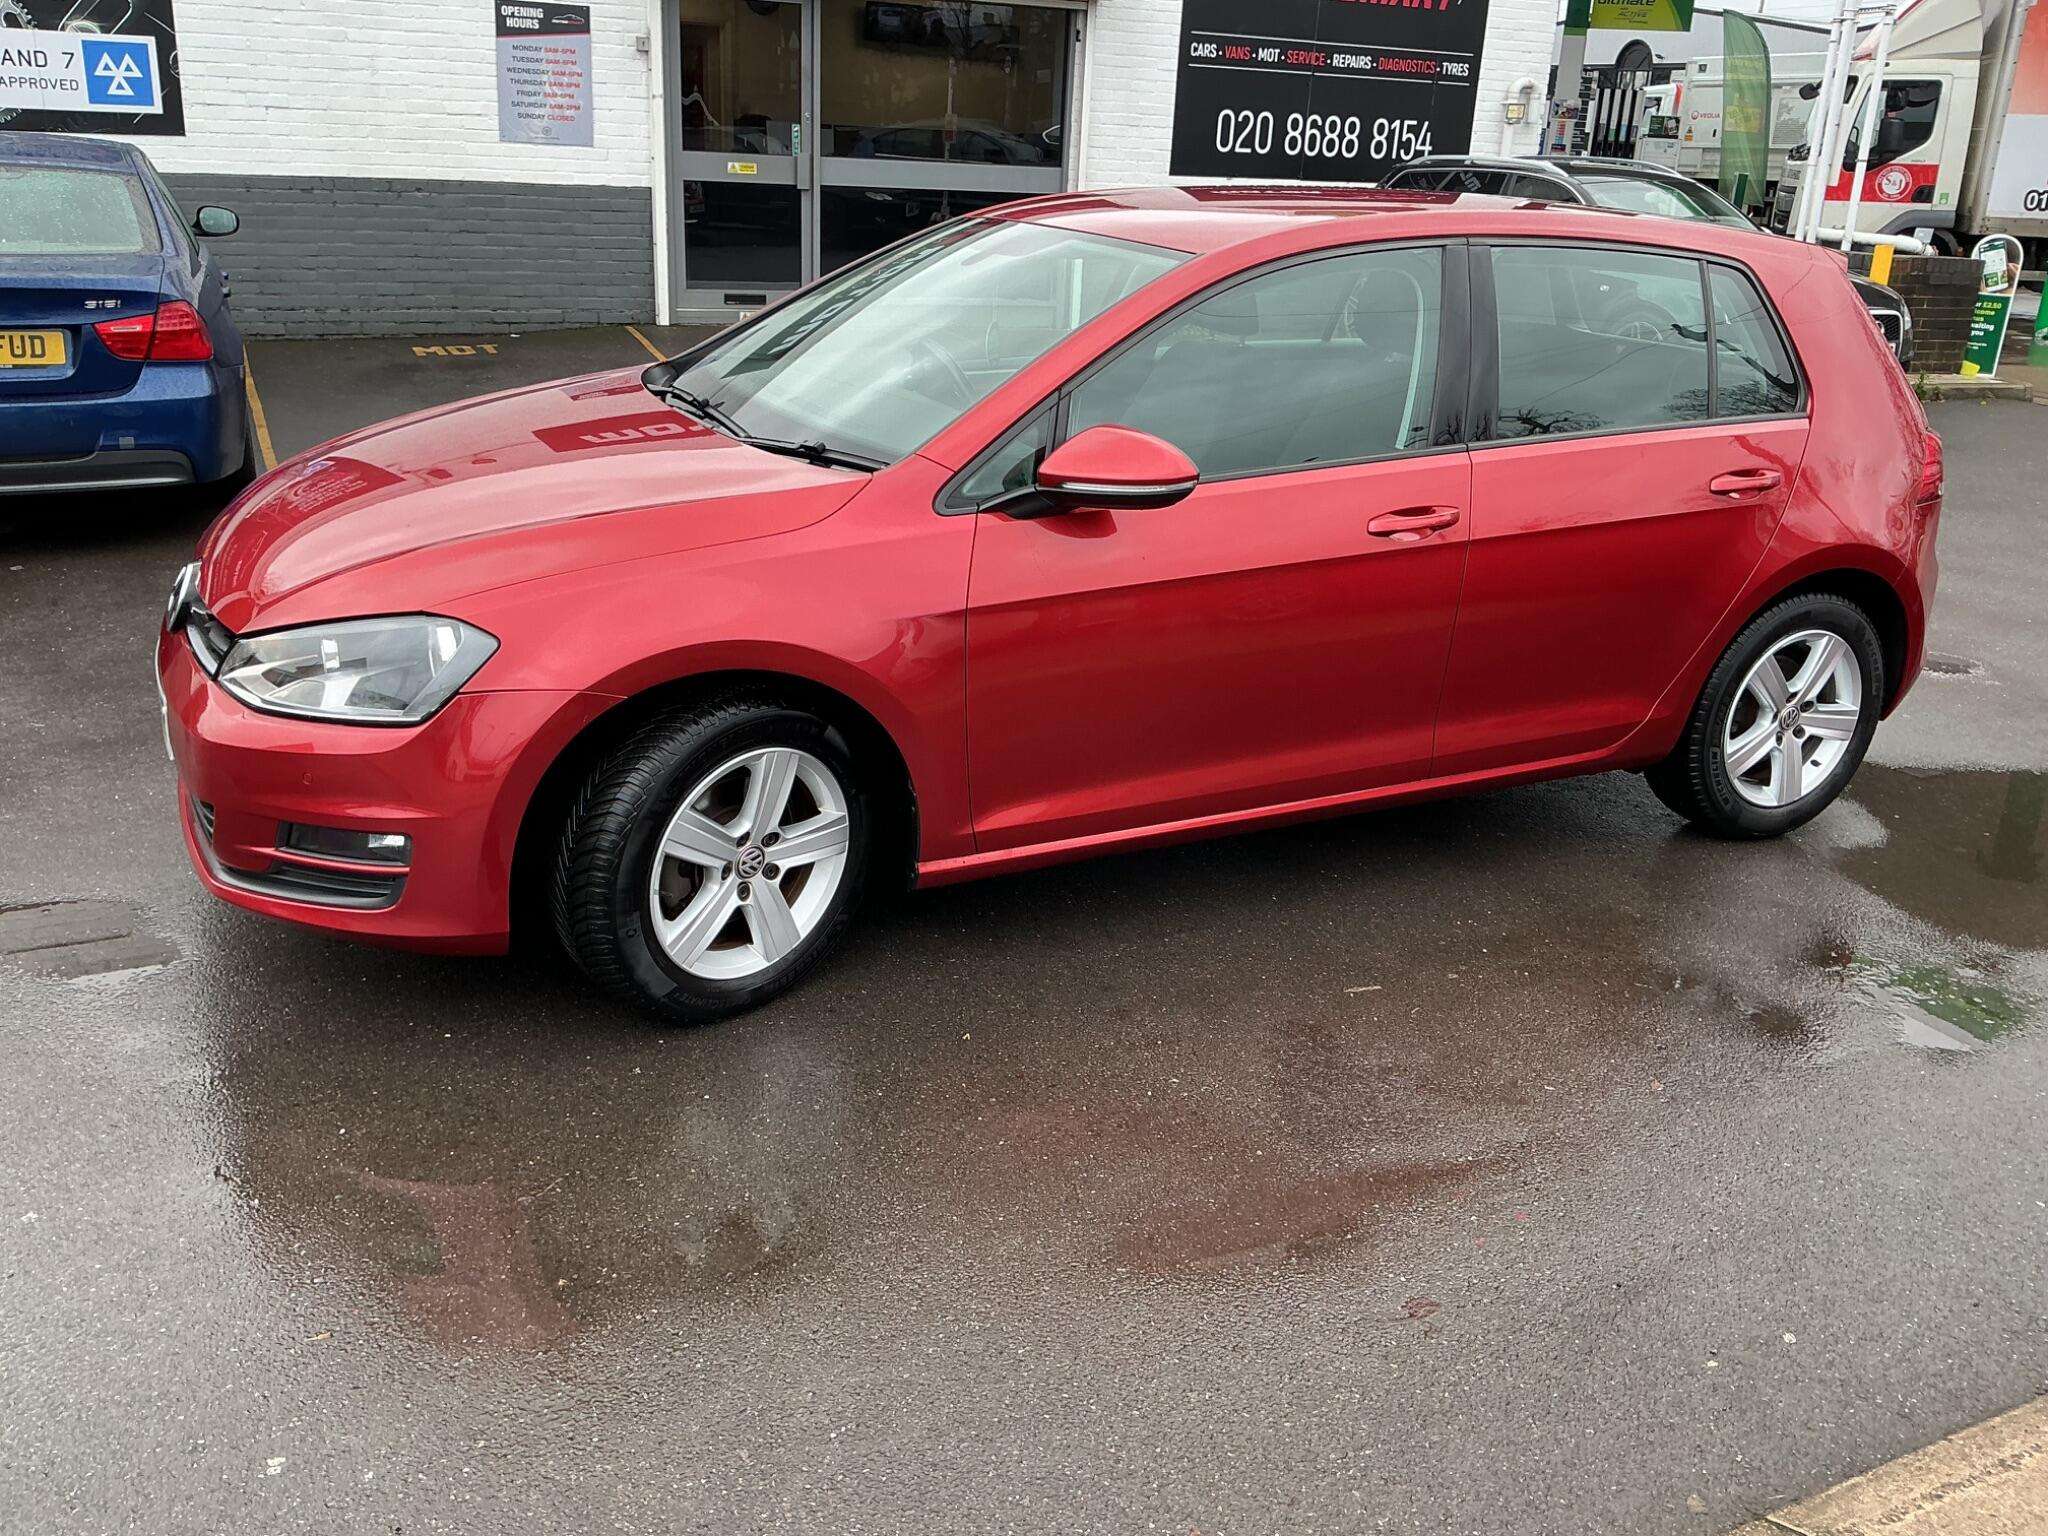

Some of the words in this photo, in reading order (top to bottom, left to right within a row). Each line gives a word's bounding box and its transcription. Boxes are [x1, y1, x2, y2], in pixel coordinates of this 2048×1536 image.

[501, 5, 544, 18] OPENING
[506, 17, 539, 29] HOURS
[512, 45, 542, 53] MONDAY
[1, 49, 48, 68] AND
[61, 52, 75, 70] 7
[512, 56, 544, 64] TUESDAY
[1190, 42, 1217, 58] CARS
[1225, 44, 1251, 60] VANS
[1258, 47, 1281, 62] MOT
[1286, 50, 1326, 66] SERVICE
[1332, 53, 1372, 69] REPAIRS
[1378, 57, 1436, 74] DIAGNOSTICS
[1442, 62, 1469, 77] TYRES
[506, 67, 549, 76] WEDNESDAY
[0, 76, 79, 91] APPROVED
[510, 78, 546, 86] THURSDAY
[511, 101, 547, 109] SATURDAY
[517, 112, 545, 120] SUNDAY
[547, 114, 576, 122] CLOSED
[1216, 109, 1274, 154] 020
[1284, 113, 1361, 159] 8688
[1369, 118, 1433, 161] 8154
[412, 344, 499, 357] MOT
